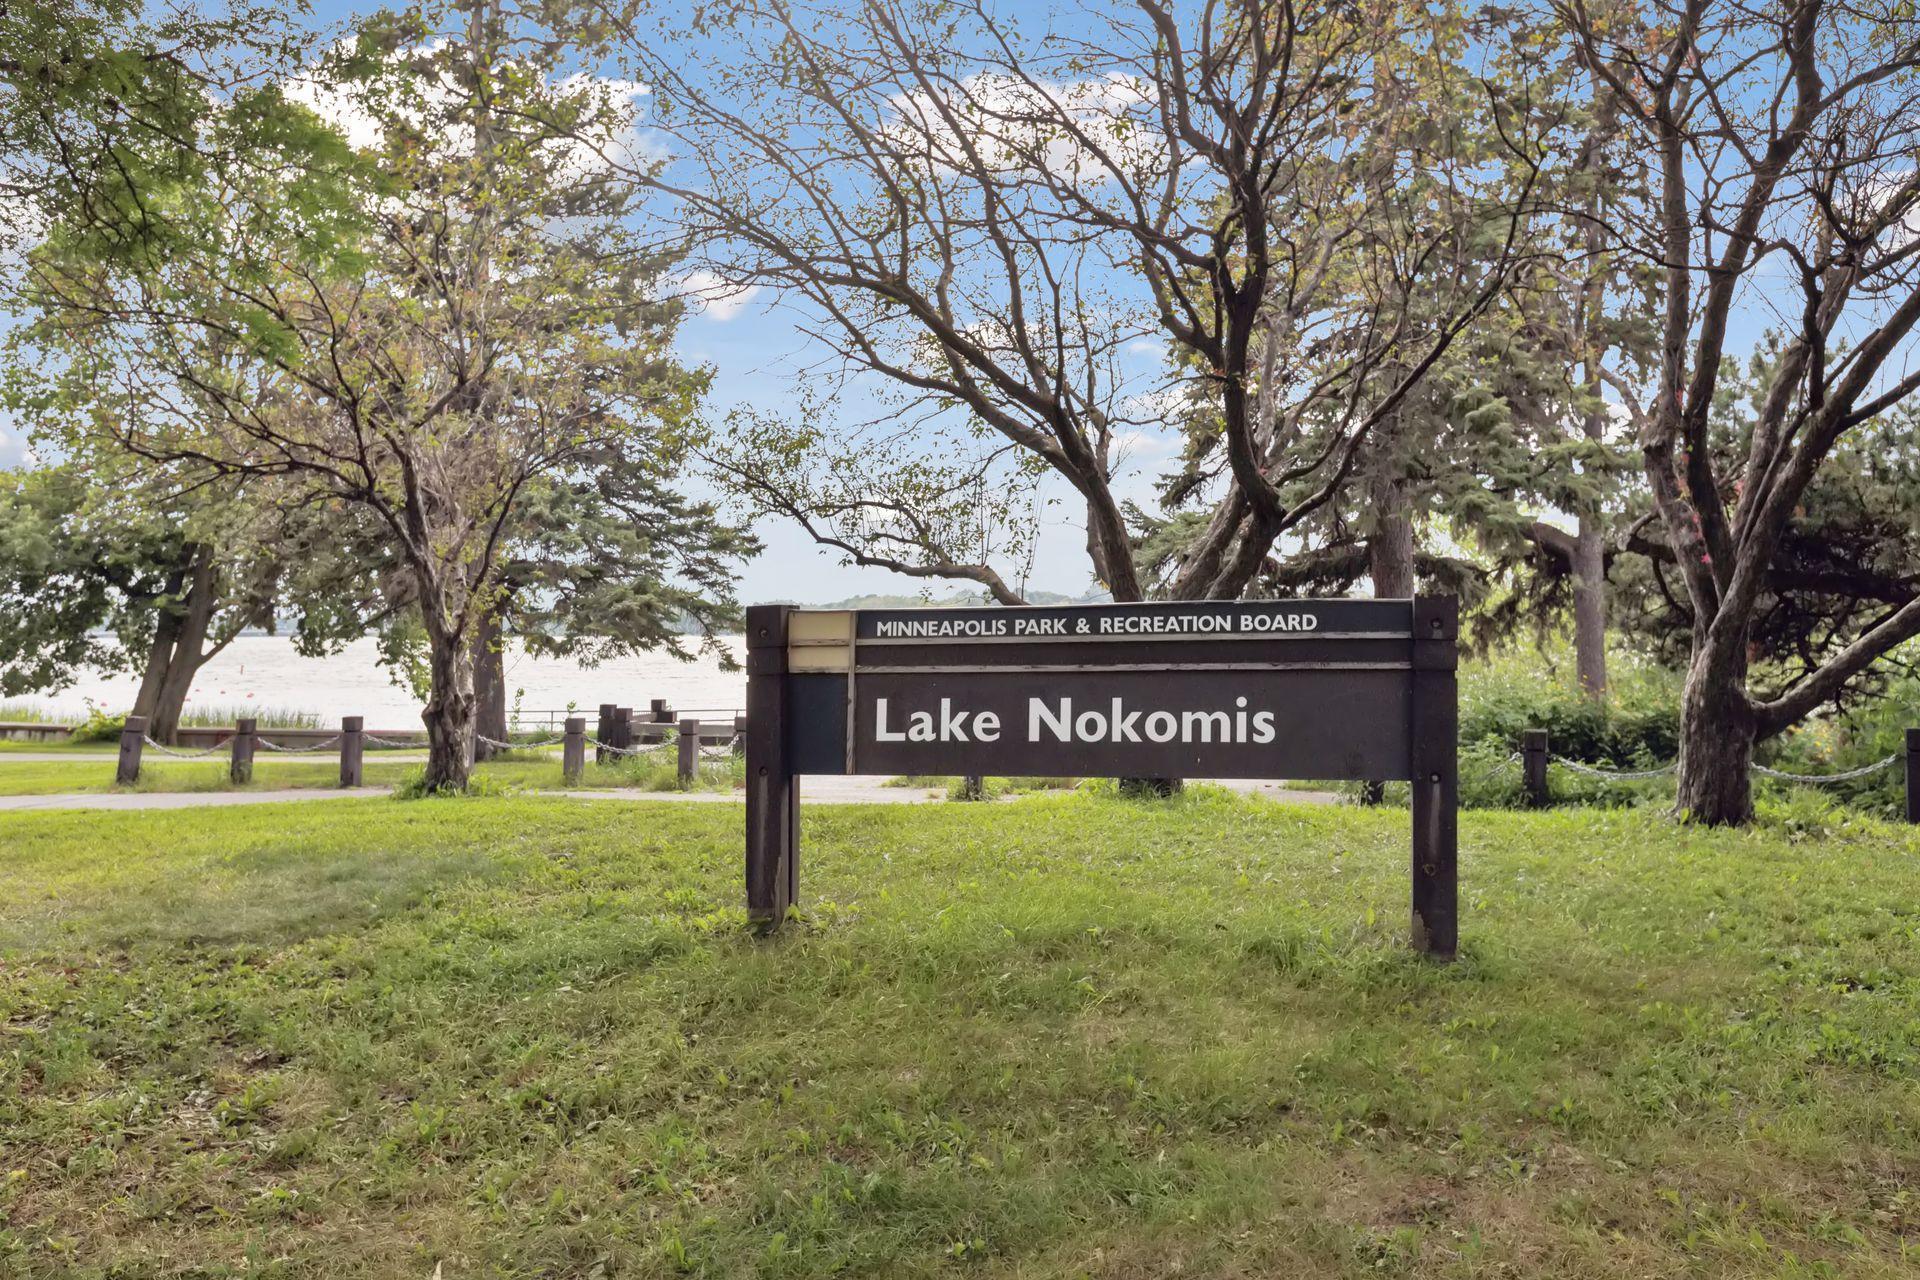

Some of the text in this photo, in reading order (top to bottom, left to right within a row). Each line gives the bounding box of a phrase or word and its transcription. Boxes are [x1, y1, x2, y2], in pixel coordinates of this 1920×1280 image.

[876, 614, 1318, 636] MINNEAPOLIS PARK & RECREATION BOARD
[875, 696, 1276, 744] Lake Nokomis
